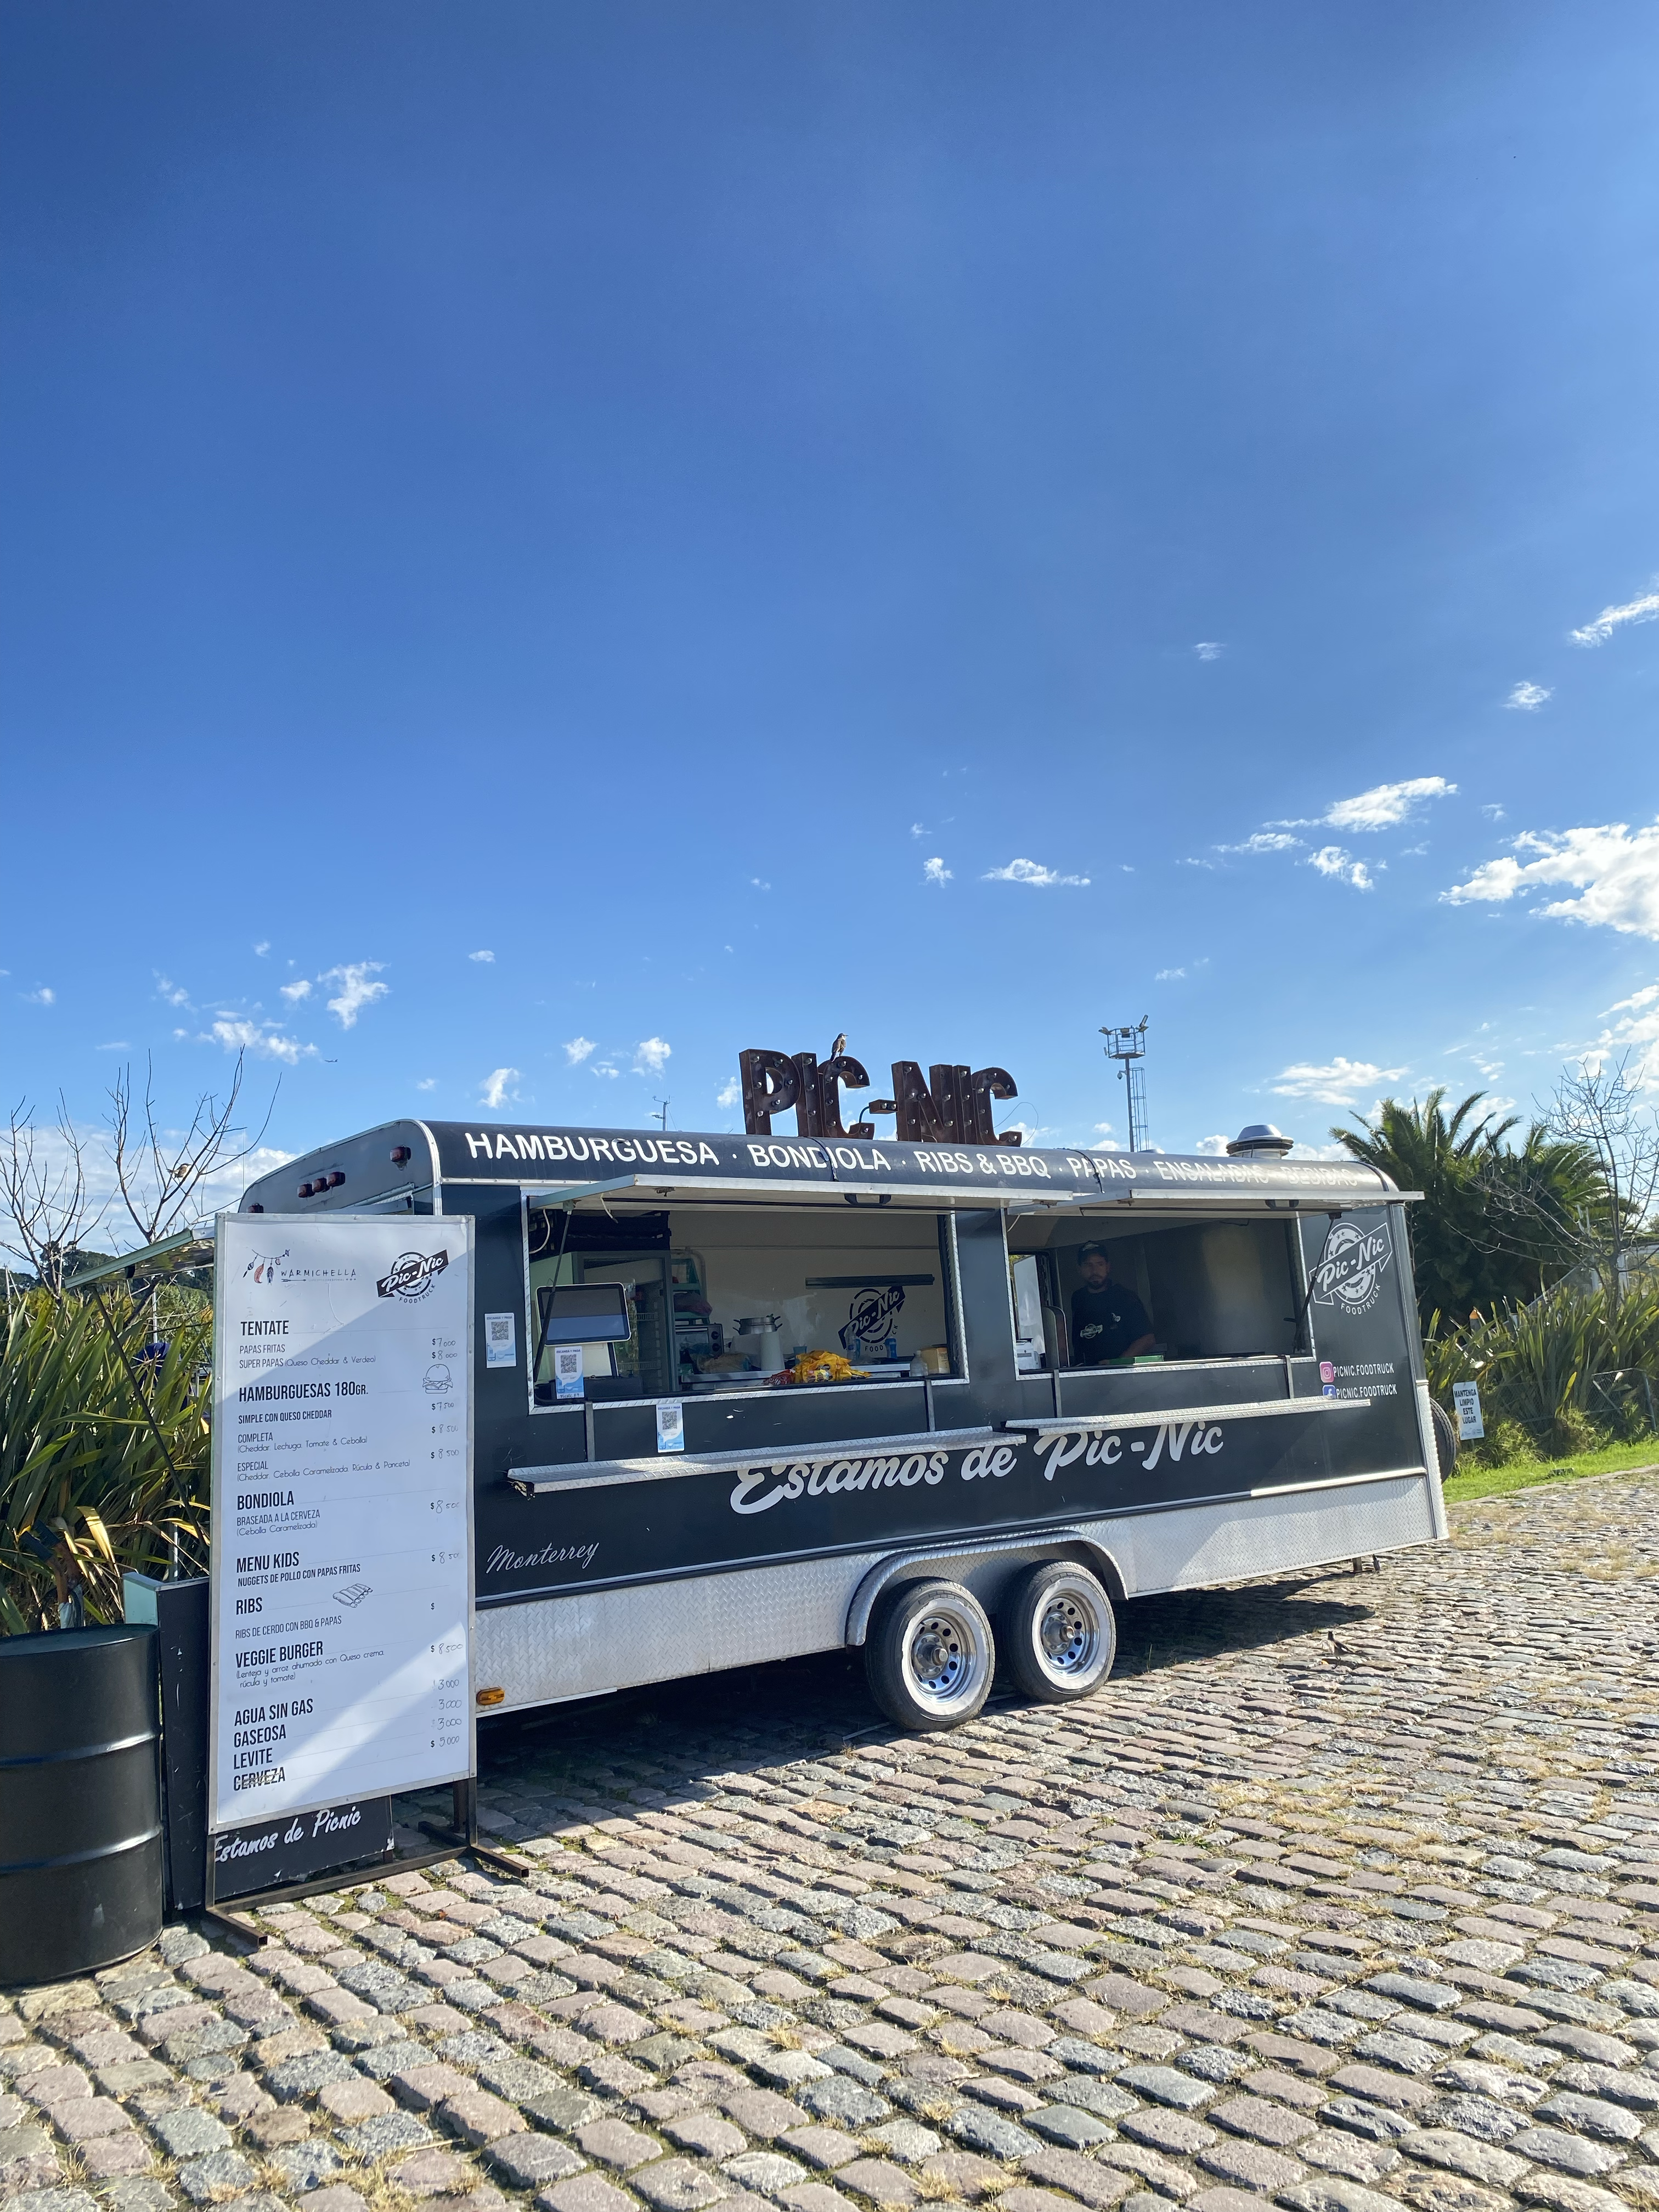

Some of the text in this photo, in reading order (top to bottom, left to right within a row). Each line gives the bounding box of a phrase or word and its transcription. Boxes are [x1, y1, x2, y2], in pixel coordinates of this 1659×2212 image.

[738, 1048, 1022, 1147] PIC-NIC
[465, 1132, 720, 1166] HAMBURGUESA
[747, 1144, 891, 1171] BONDIOLA
[913, 1151, 974, 1175] RIBS
[975, 1153, 997, 1175] &
[996, 1154, 1052, 1180] BBQ
[281, 1268, 356, 1278] WARMICHELLA
[1317, 1237, 1384, 1291] Pic-Nic
[381, 1257, 444, 1292] Pic-Nic
[399, 1284, 436, 1304] FOODTRUCK
[1341, 1284, 1381, 1314] FOODTRUCK
[241, 1320, 289, 1336] TENTATE
[865, 1325, 898, 1352] FOODCK
[240, 1344, 285, 1355] PAPAS FRITAS
[239, 1359, 261, 1369] SUPER
[262, 1358, 284, 1367] PAPAS
[285, 1358, 308, 1367] (Queso
[311, 1356, 340, 1365] Cheddar
[351, 1355, 376, 1363] Verdeo)
[1333, 1363, 1394, 1378] PICNIC.FOODTRUCK
[239, 1383, 331, 1402] HAMBURGUESAS
[1336, 1384, 1397, 1399] PICNIC.FOODTRUCK
[1454, 1389, 1477, 1398] MANTENGA
[238, 1409, 332, 1424] SIMPLE CON QUESO CHEDDAR
[1462, 1416, 1477, 1424] LUGAR
[238, 1432, 273, 1443] COMPLETA
[305, 1440, 329, 1448] Tomate
[341, 1436, 368, 1445] Cebolla)
[238, 1460, 268, 1471] ESPECIAL
[273, 1469, 300, 1479] Cebolla
[352, 1463, 373, 1471] Rúcula
[383, 1459, 410, 1469] Panceta)
[730, 1421, 1223, 1514] Estamos de Pic-Nic
[237, 1491, 295, 1510] BONDIOLA
[236, 1509, 320, 1526] BRASEADA A LA CERVEZA
[236, 1520, 318, 1536] (Cebolla Caramelizada)
[236, 1551, 300, 1573] MENU KIDS
[486, 1542, 600, 1574] Monterrey
[238, 1564, 361, 1588] NUGGETS DE POLLO CON PAPAS FRITAS
[236, 1597, 262, 1615] RIBS
[235, 1616, 342, 1639] RIBS DE CERDO CON BBQ & PAPAS
[236, 1641, 323, 1668] VEGGIE BURGER
[236, 1669, 262, 1680] (Lenteja
[272, 1665, 289, 1673] arroz
[292, 1658, 323, 1670] ahumado
[340, 1653, 360, 1662] Queso
[240, 1677, 260, 1688] rúcula
[270, 1672, 296, 1683] tomate)
[234, 1698, 313, 1726] AGUA SIN GAS
[234, 1724, 286, 1748] GASEOSA
[233, 1747, 273, 1770] LEVITE
[233, 1767, 285, 1791] CERVEZA
[215, 1806, 361, 1863] Estamos de Picnic
